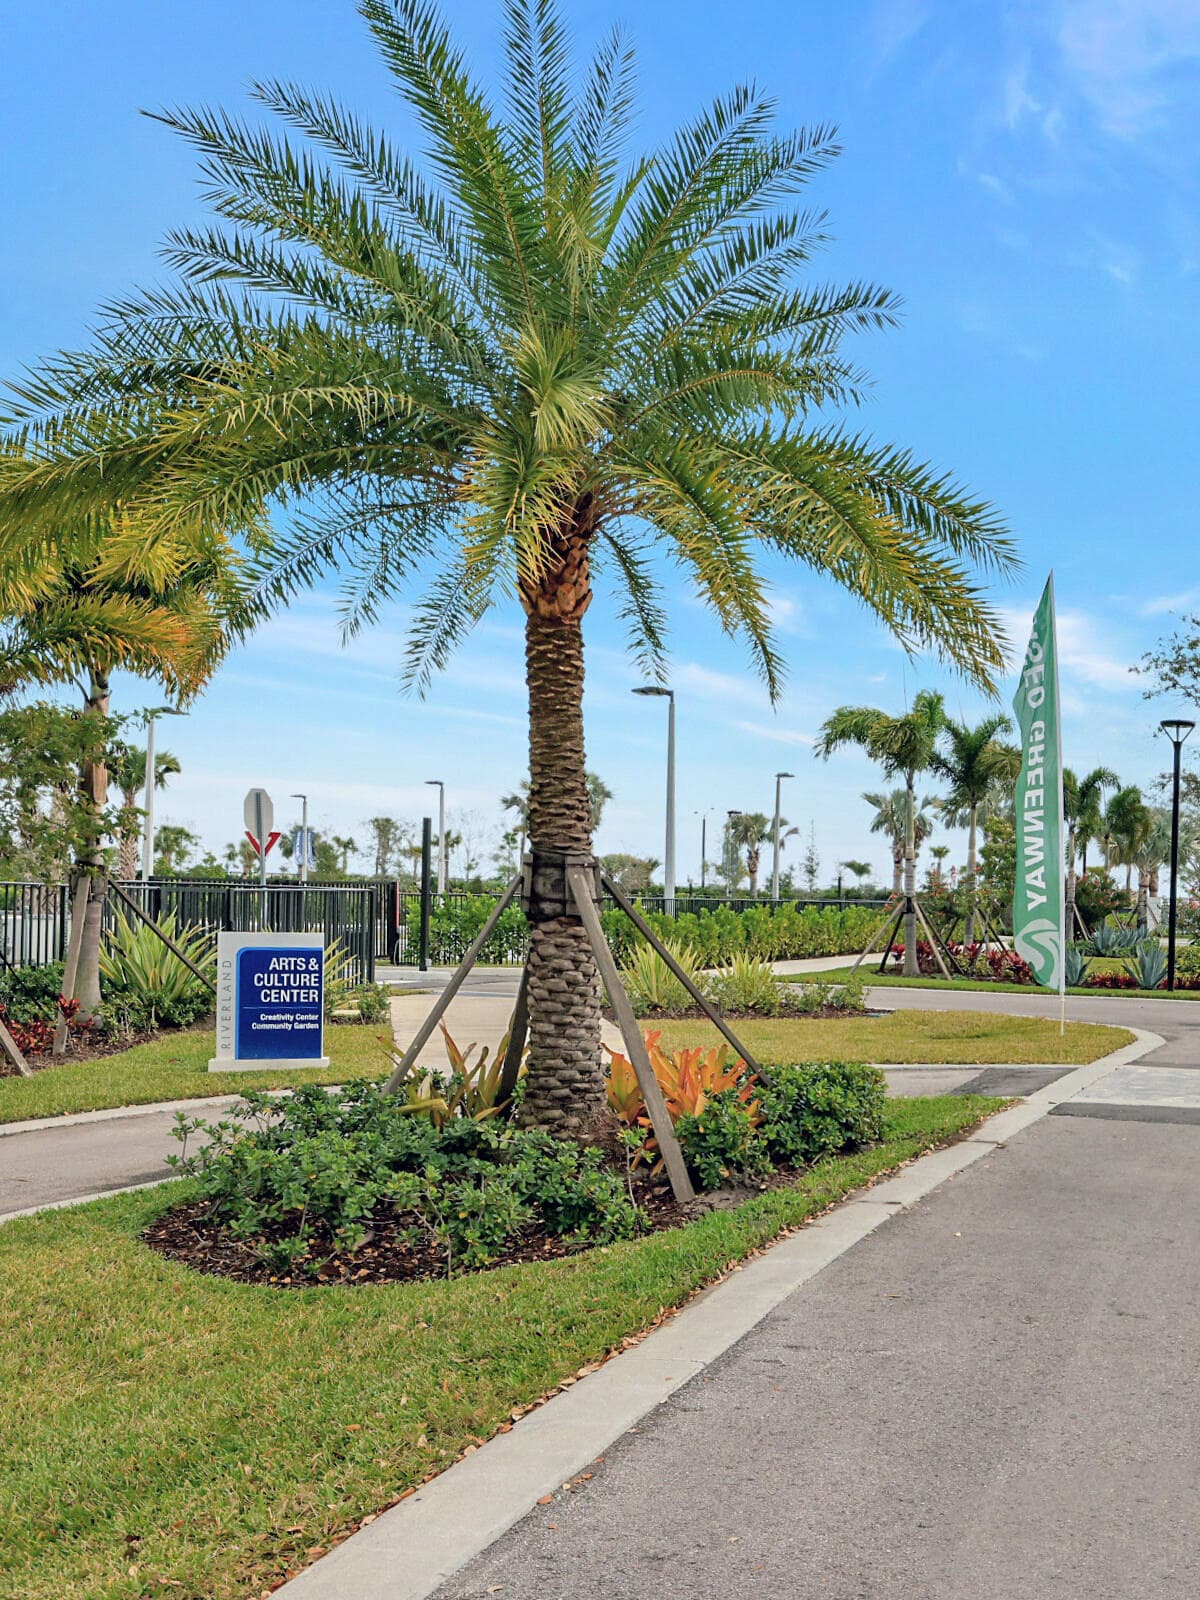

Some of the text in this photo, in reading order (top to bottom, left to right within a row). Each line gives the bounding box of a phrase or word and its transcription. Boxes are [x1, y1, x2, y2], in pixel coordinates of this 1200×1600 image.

[269, 957, 319, 971] ARTS &
[254, 973, 320, 987] CULTURE
[260, 989, 319, 1003] CENTER
[221, 960, 232, 1049] RIVERLAND
[260, 1013, 319, 1022] Creativity Center
[251, 1022, 319, 1031] Community Garden
